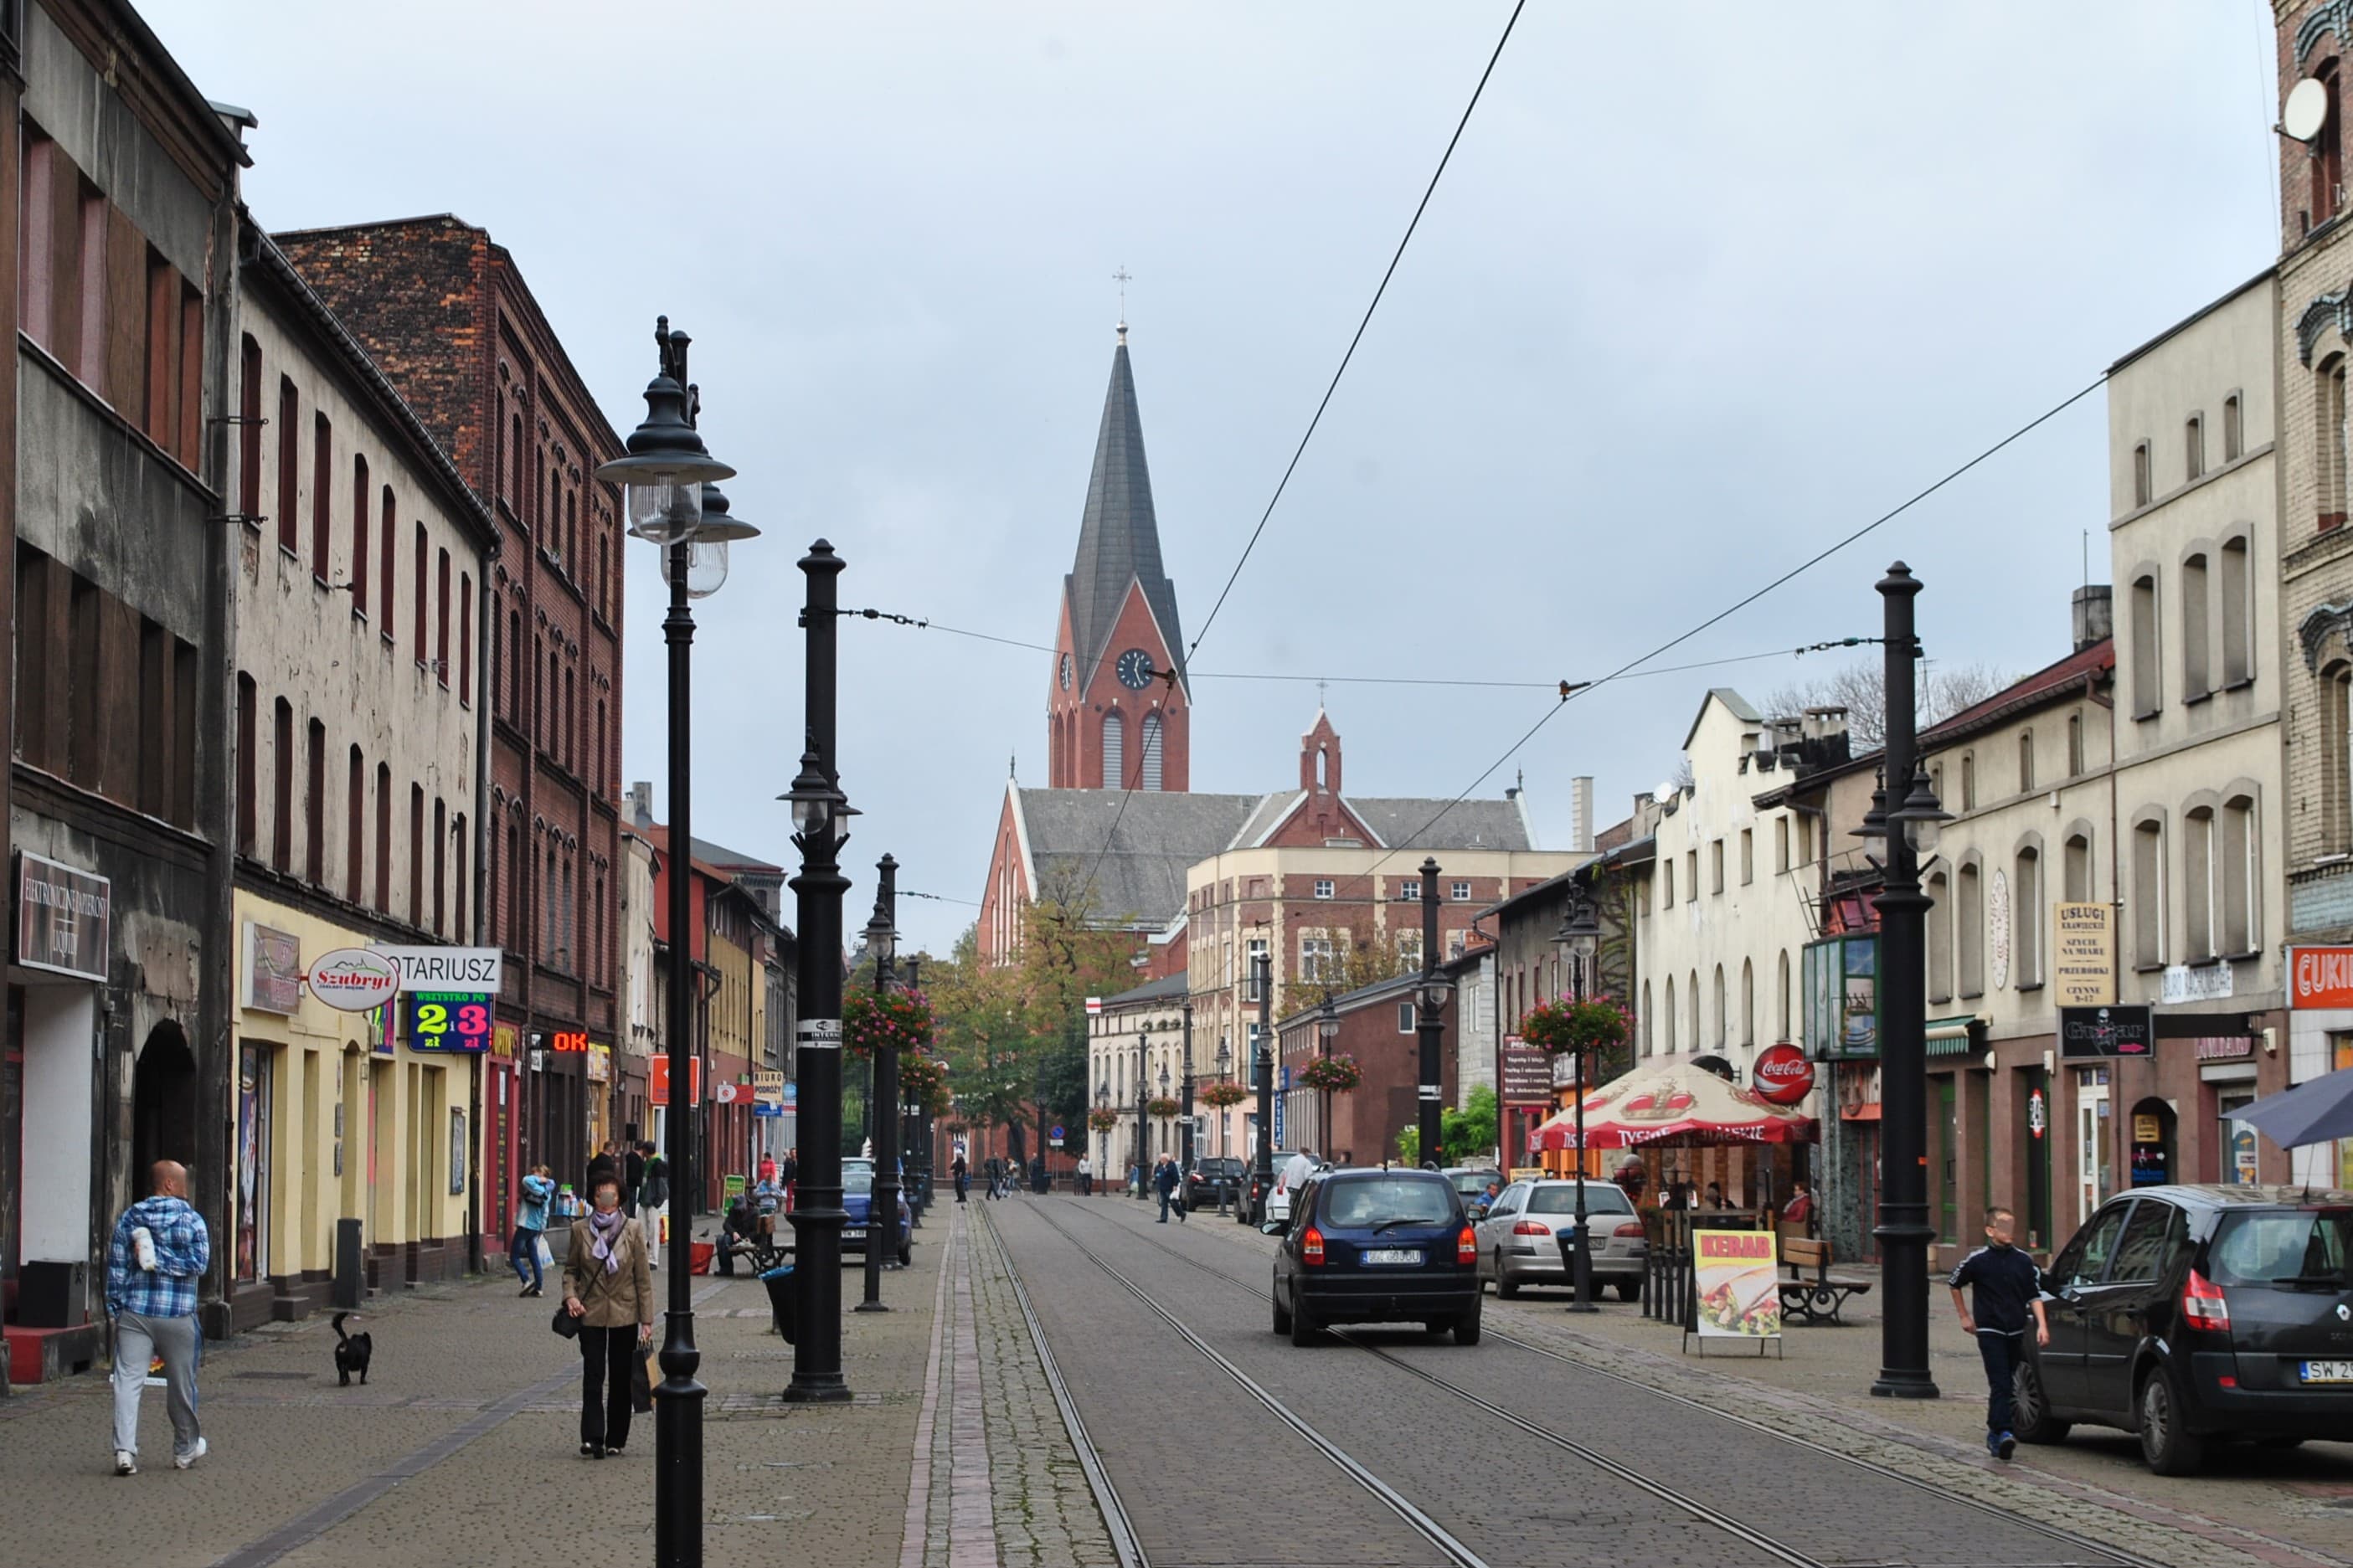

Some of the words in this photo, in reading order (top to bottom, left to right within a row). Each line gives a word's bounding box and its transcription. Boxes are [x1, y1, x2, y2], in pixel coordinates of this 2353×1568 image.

[26, 877, 75, 912] ELEKTRONICZNE
[76, 890, 107, 919] PAPIEROSY
[388, 956, 496, 982] OTARIUSZ
[317, 970, 391, 990] Szubryt
[416, 992, 469, 1002] WSZYSTKO
[472, 993, 487, 1002] PO
[417, 1004, 448, 1035] 2
[450, 1020, 456, 1032] i
[457, 1005, 487, 1035] 3
[425, 1036, 440, 1047] zł
[465, 1036, 480, 1047] zł
[553, 1032, 587, 1051] OK
[755, 1073, 782, 1082] BIURO
[1563, 1131, 1588, 1149] TYSE
[1716, 1125, 1765, 1141] SKIE
[1701, 1235, 1771, 1258] KEBAB
[2311, 1362, 2334, 1379] SW
